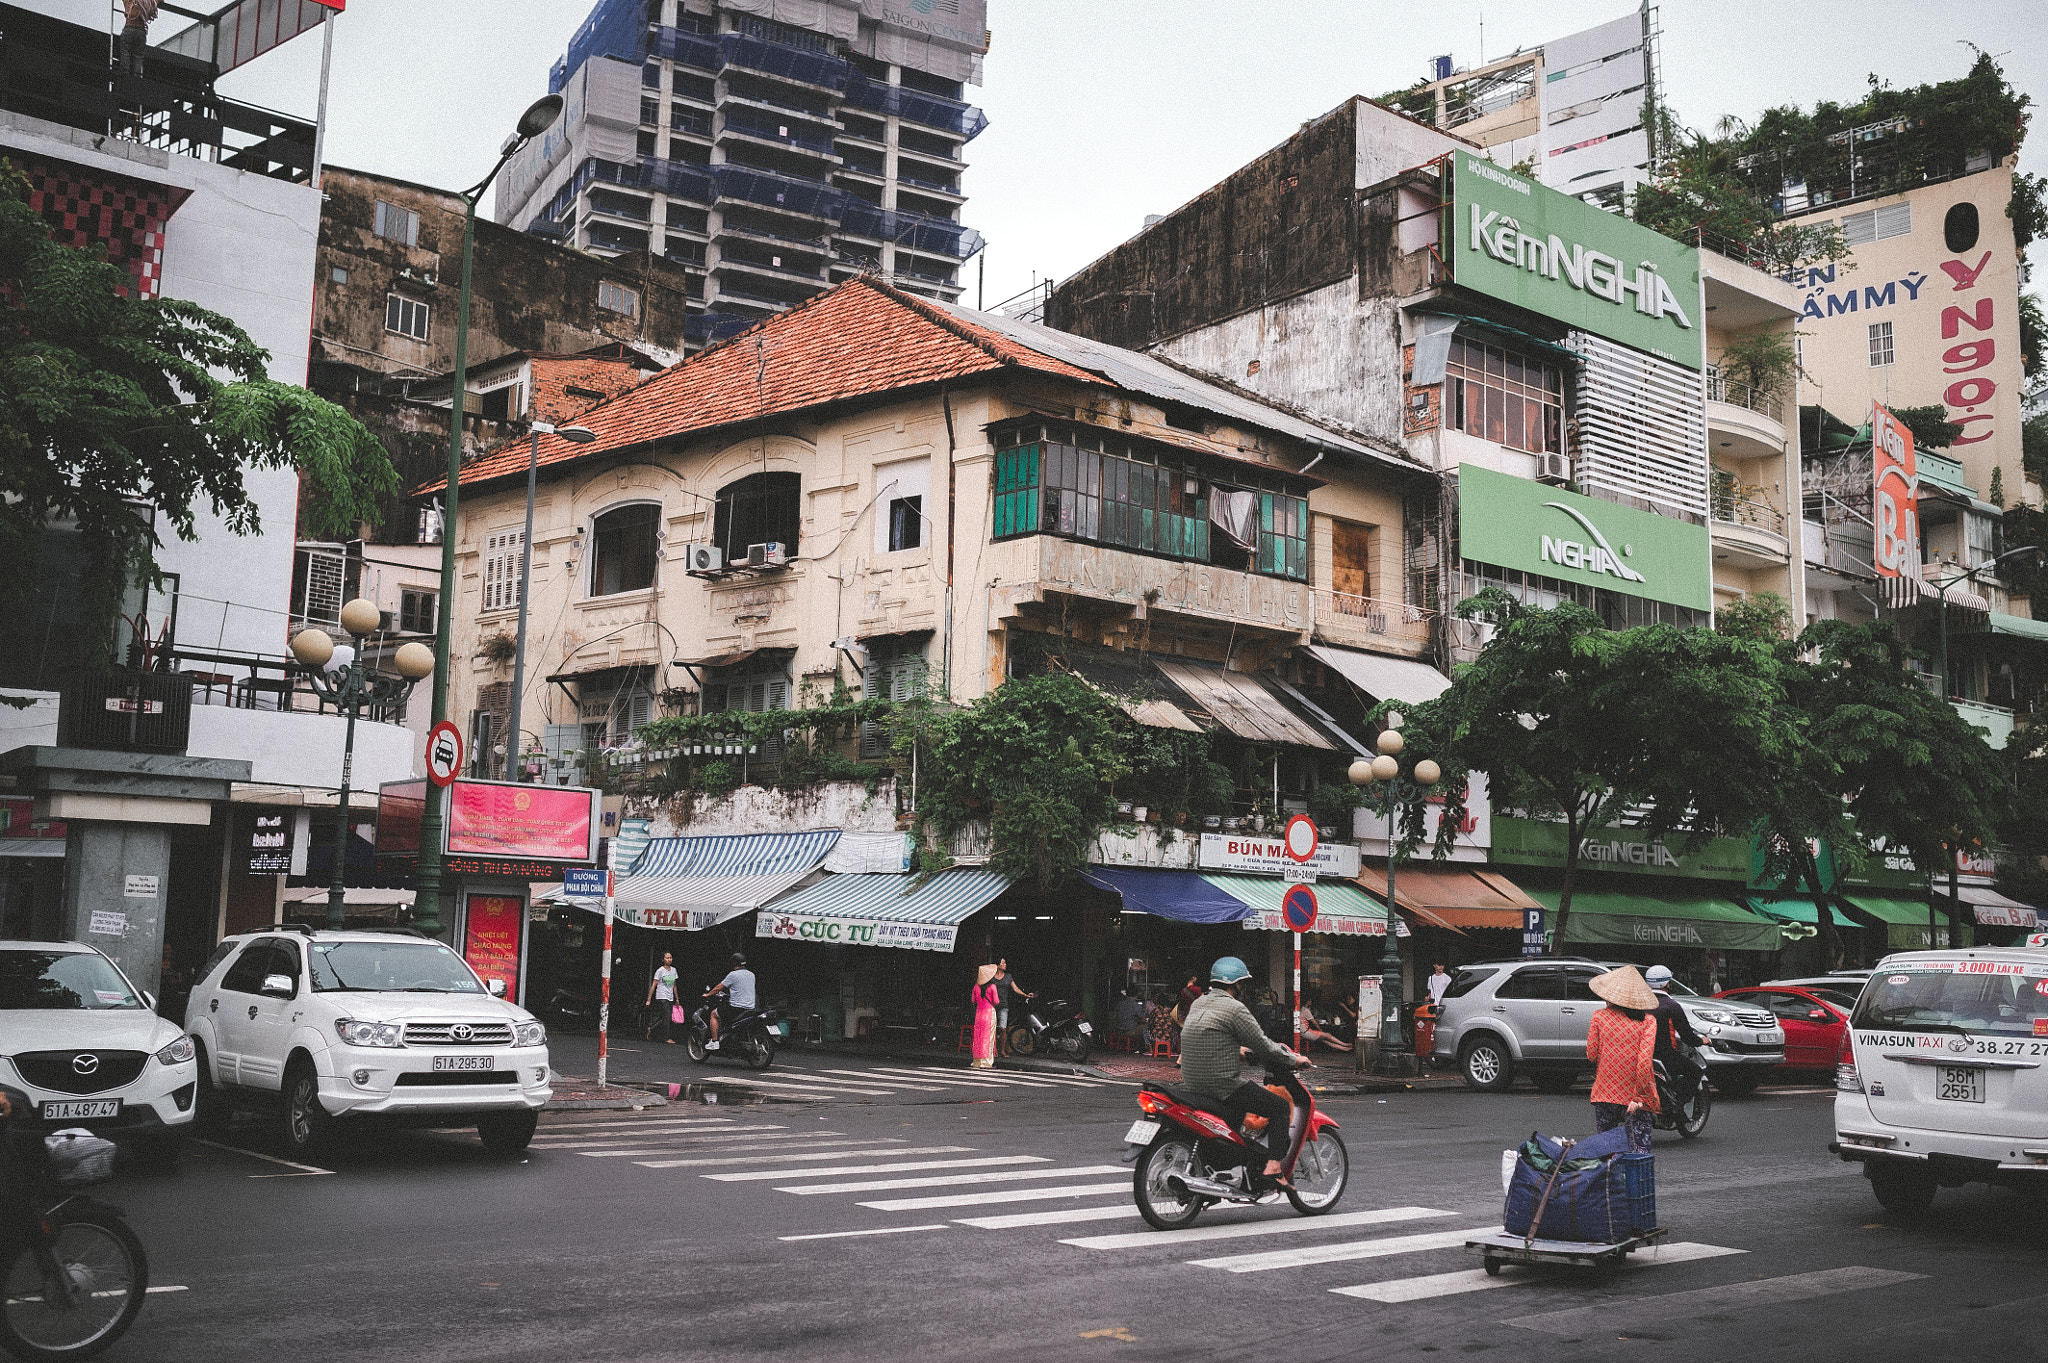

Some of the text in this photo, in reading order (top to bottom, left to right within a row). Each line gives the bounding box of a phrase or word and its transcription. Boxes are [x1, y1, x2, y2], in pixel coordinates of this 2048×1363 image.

[882, 8, 931, 32] SAIGON
[1227, 839, 1263, 857] BÚN
[573, 871, 599, 881] ĐƯỜNG
[566, 882, 580, 892] PHAN
[580, 881, 590, 894] BỘI
[644, 908, 689, 928] THAI
[1529, 910, 1540, 930] P
[799, 918, 842, 940] CÚC
[1958, 961, 1995, 974] 3.000
[2012, 965, 2025, 975] XE
[1859, 1034, 1944, 1048] VINASUN TAXI
[1976, 1041, 2026, 1056] 38.27
[1946, 1068, 1975, 1085] 56M
[1941, 1085, 1976, 1101] 2551
